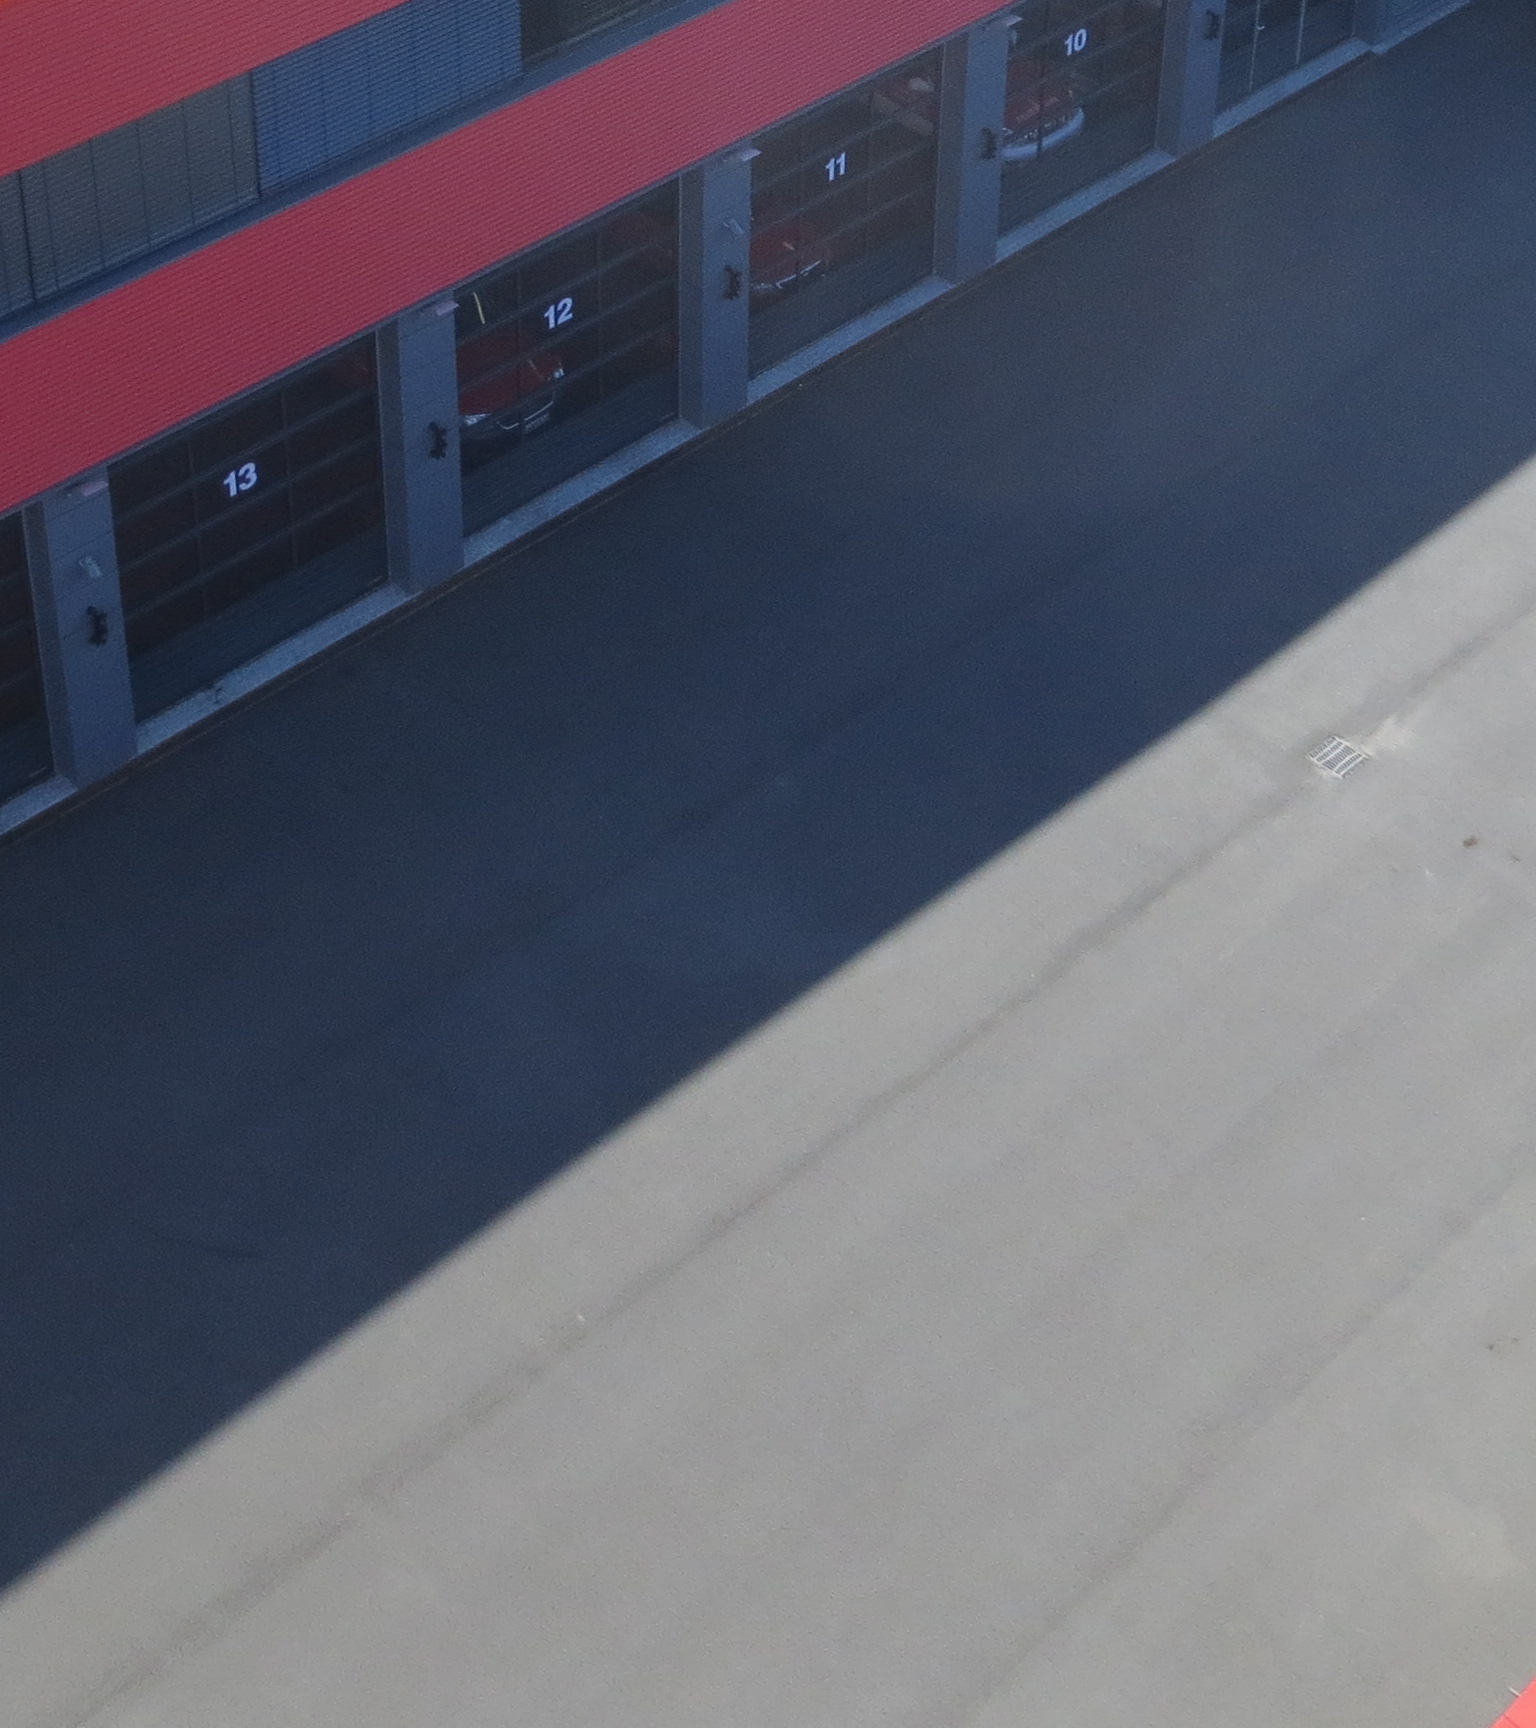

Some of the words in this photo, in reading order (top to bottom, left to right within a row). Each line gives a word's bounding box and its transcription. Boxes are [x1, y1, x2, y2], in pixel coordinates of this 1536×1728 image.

[1064, 29, 1086, 55] 10
[825, 153, 845, 180] 11
[544, 298, 572, 329] 12
[224, 462, 256, 496] 13
